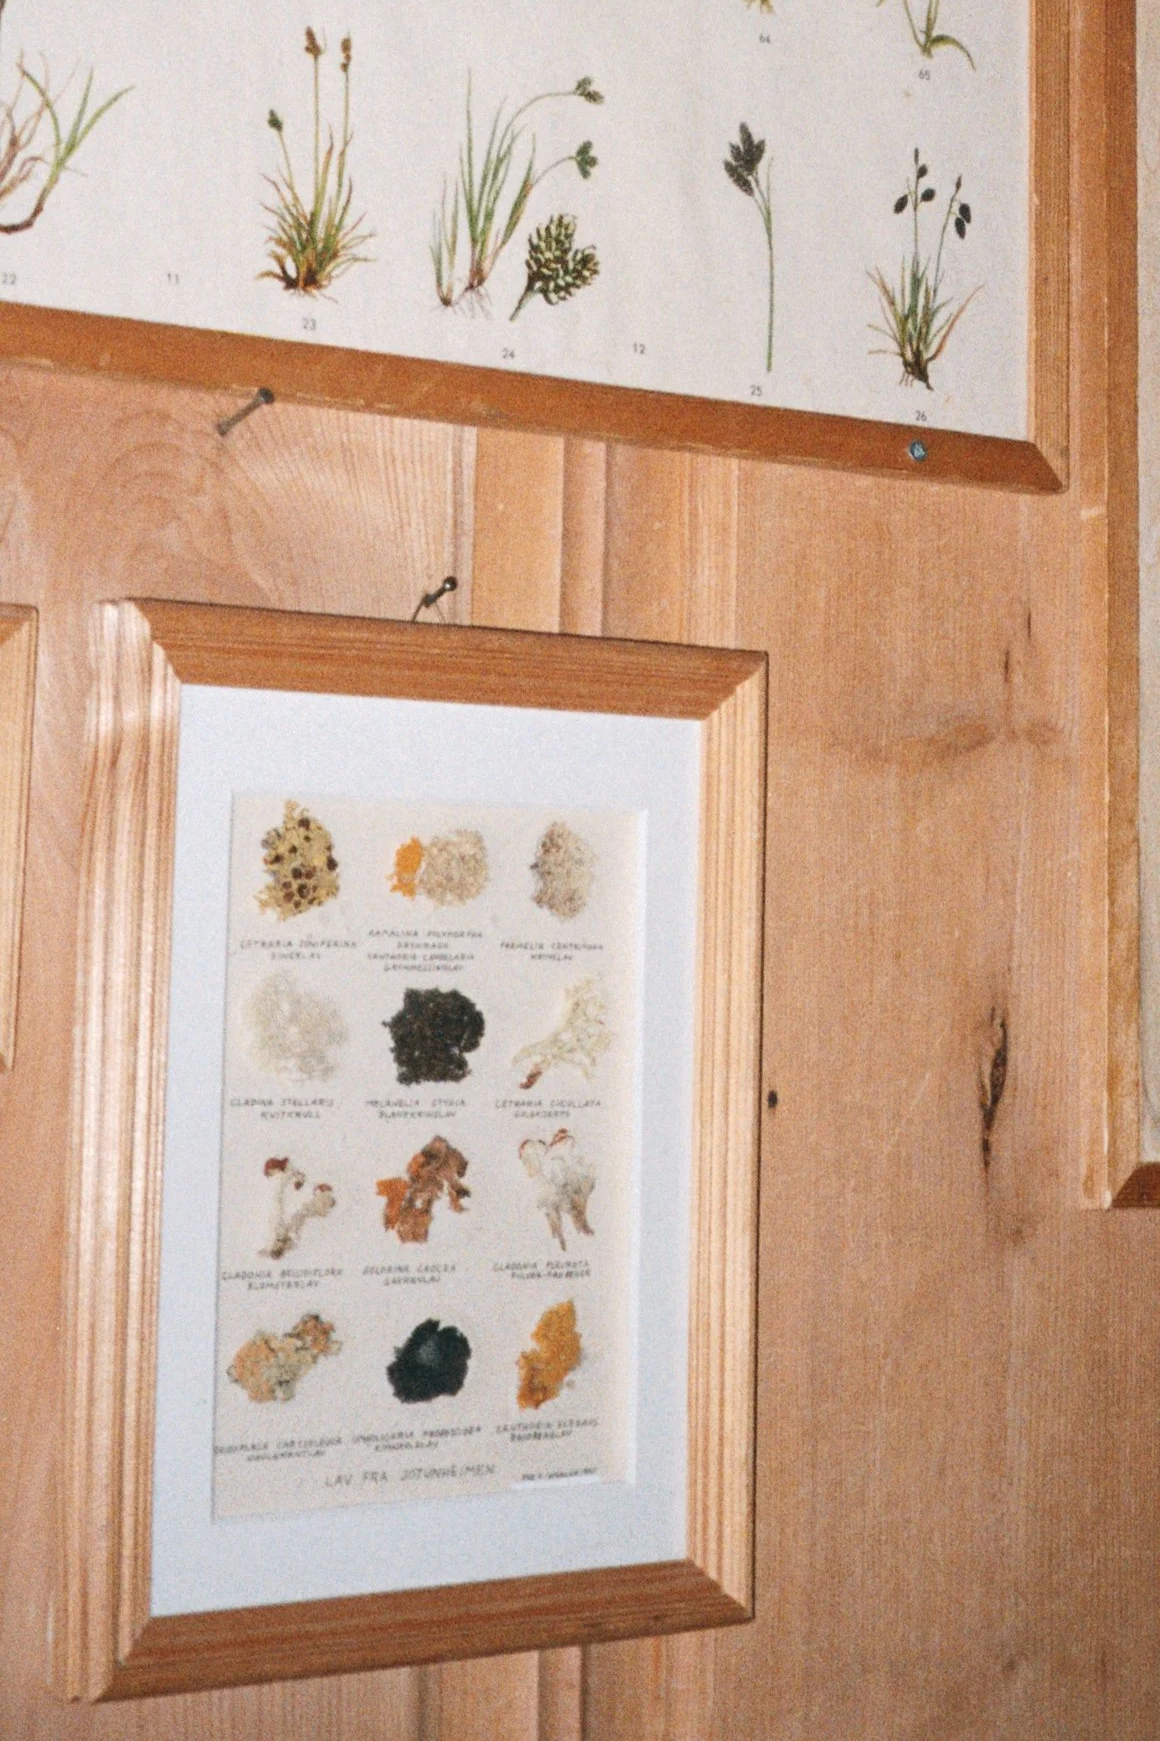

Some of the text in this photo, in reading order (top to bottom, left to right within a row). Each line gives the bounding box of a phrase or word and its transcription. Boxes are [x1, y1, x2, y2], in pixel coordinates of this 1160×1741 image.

[758, 32, 771, 44] 64
[918, 69, 931, 81] 65
[2, 272, 17, 285] 22
[167, 273, 179, 285] 11
[302, 317, 316, 331] 23
[502, 347, 515, 359] 24
[633, 342, 646, 355] 12
[750, 385, 763, 396] 25
[915, 410, 927, 422] 26
[325, 1473, 352, 1487] LAV
[363, 1471, 388, 1483] FRA
